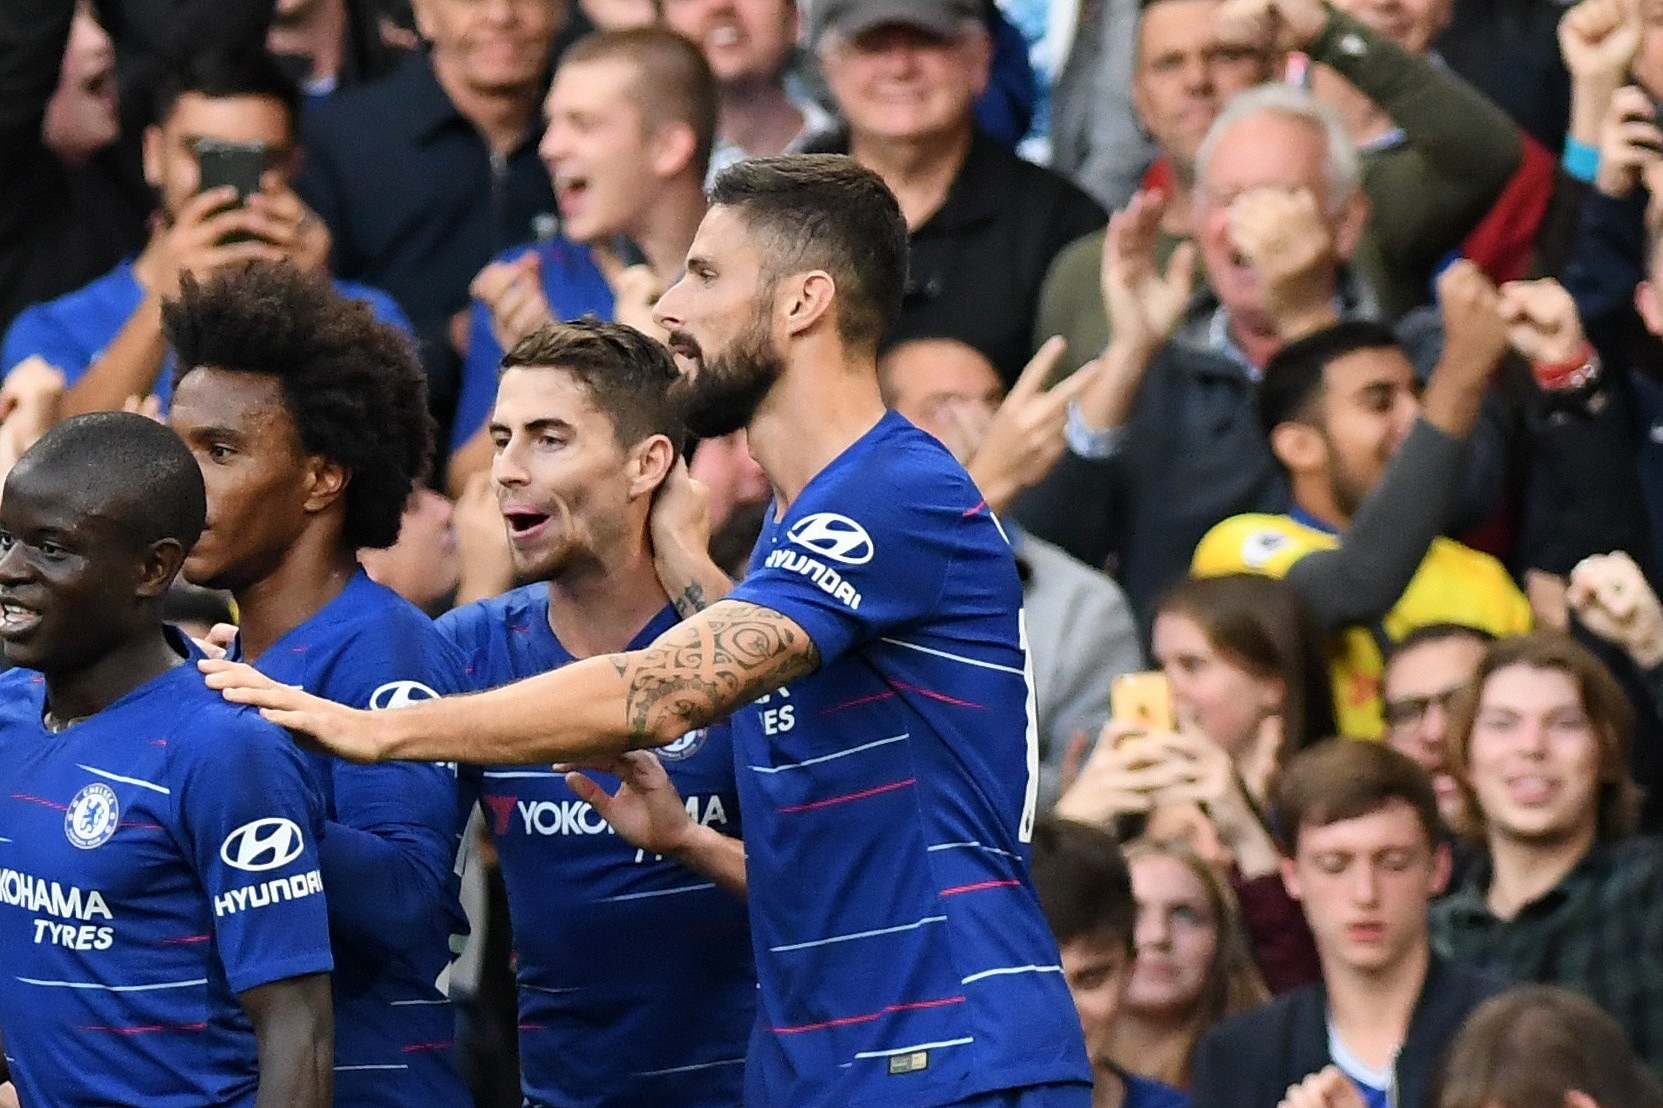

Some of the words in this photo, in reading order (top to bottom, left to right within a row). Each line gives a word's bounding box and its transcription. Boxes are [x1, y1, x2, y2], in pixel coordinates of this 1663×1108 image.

[517, 795, 728, 836] YOKOMA
[214, 869, 323, 916] HYUNDAI
[34, 918, 114, 951] TYRES
